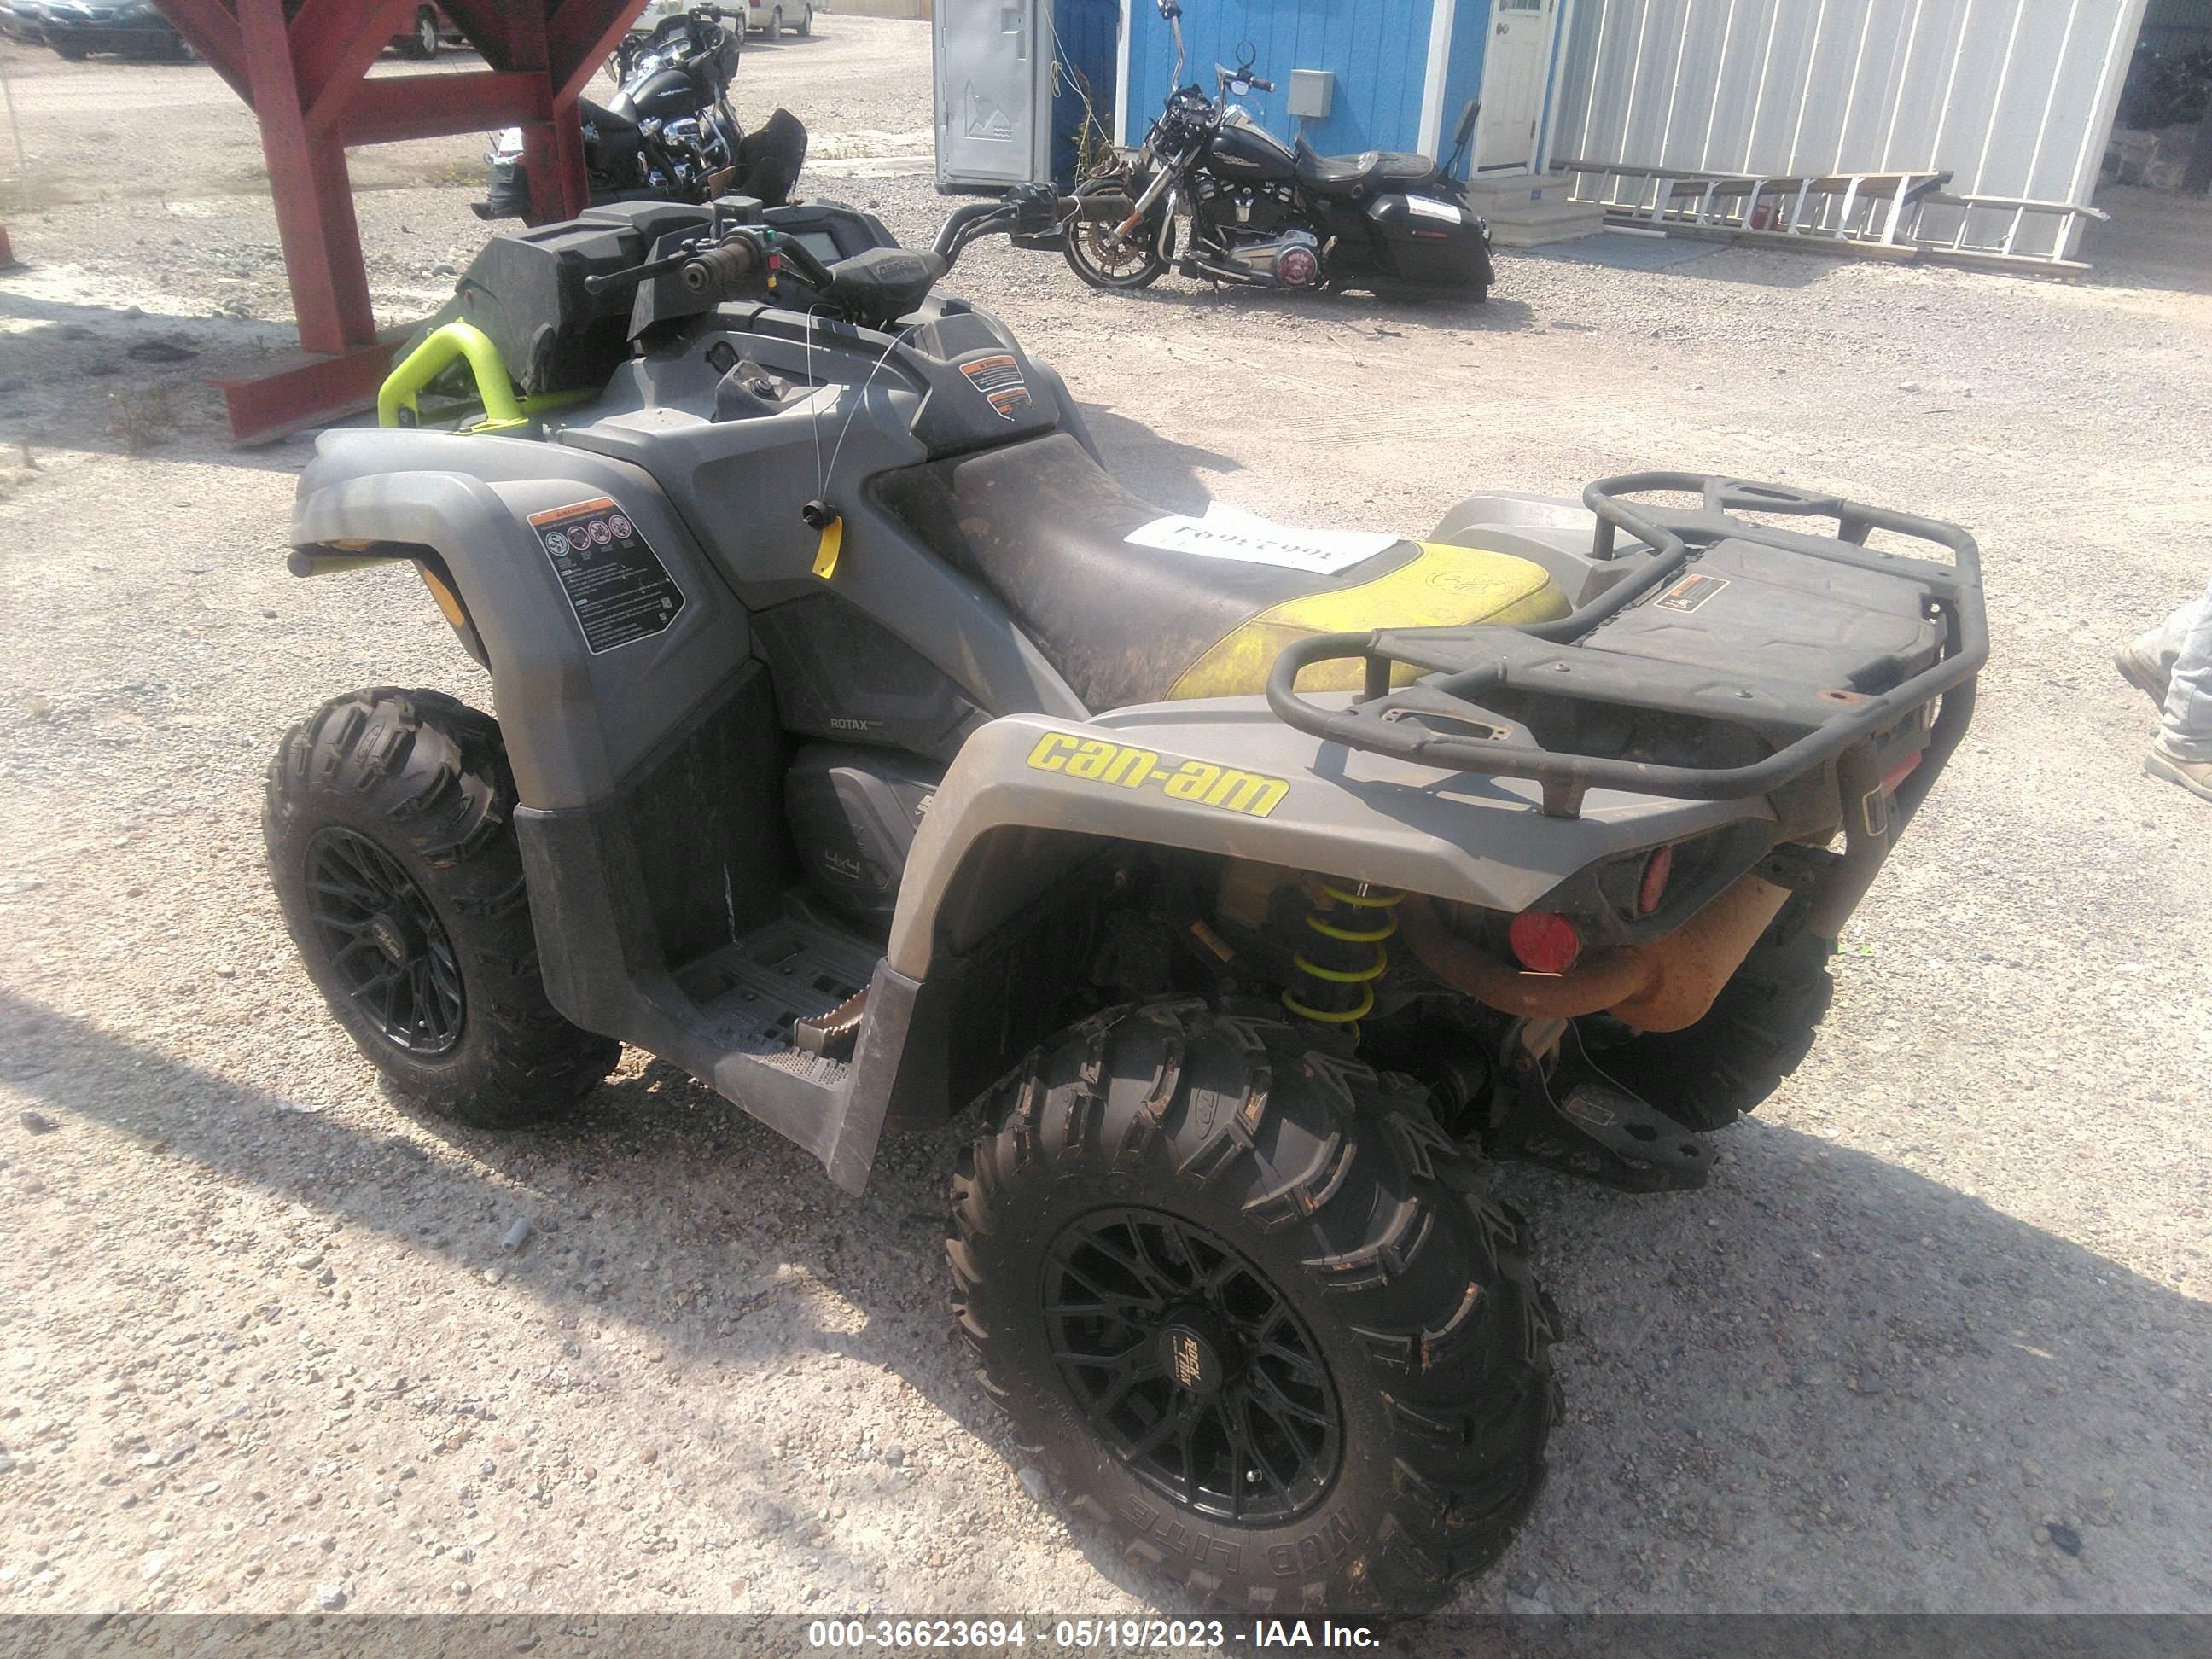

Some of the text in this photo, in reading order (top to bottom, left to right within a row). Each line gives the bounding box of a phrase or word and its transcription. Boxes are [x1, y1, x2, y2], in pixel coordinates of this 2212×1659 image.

[830, 718, 869, 731] ROTAX
[1026, 731, 1291, 818] can-am
[1183, 1336, 1201, 1381] ROCK
[1119, 1494, 1360, 1576] MUD LITE
